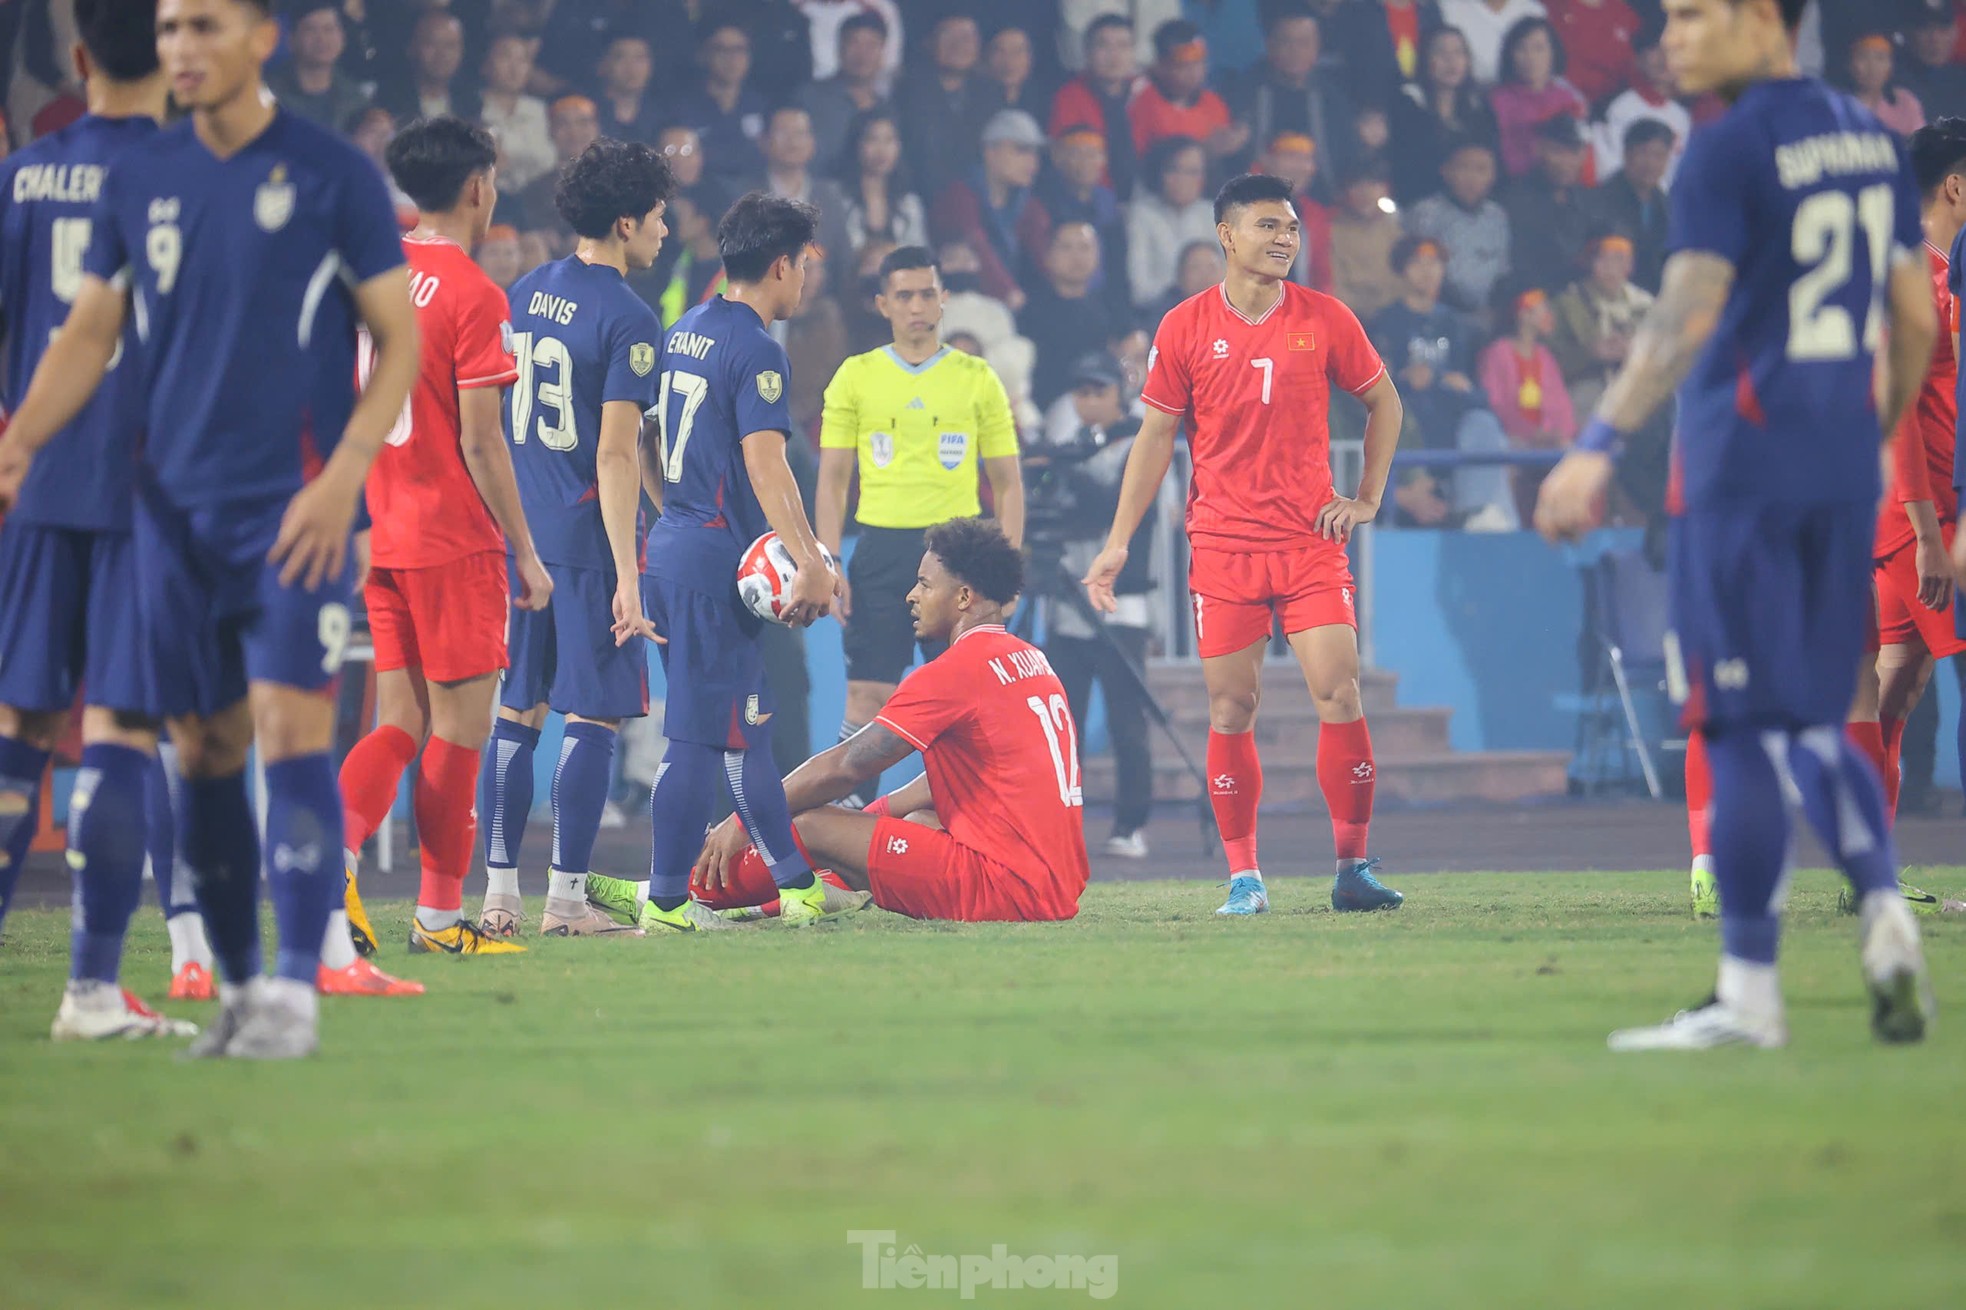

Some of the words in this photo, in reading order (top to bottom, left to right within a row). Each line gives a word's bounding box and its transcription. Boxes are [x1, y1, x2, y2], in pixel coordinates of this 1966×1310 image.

[13, 163, 108, 204] CHALER
[146, 223, 182, 295] 9
[1786, 182, 1894, 363] 21
[528, 290, 578, 326] DAVIS
[667, 331, 715, 361] EKANIT
[511, 331, 578, 452] 13
[1250, 357, 1274, 405] 7
[657, 370, 709, 484] 17
[941, 434, 964, 445] FIFA
[318, 602, 351, 674] 9
[988, 657, 1016, 686] N.
[1026, 694, 1083, 807] 12
